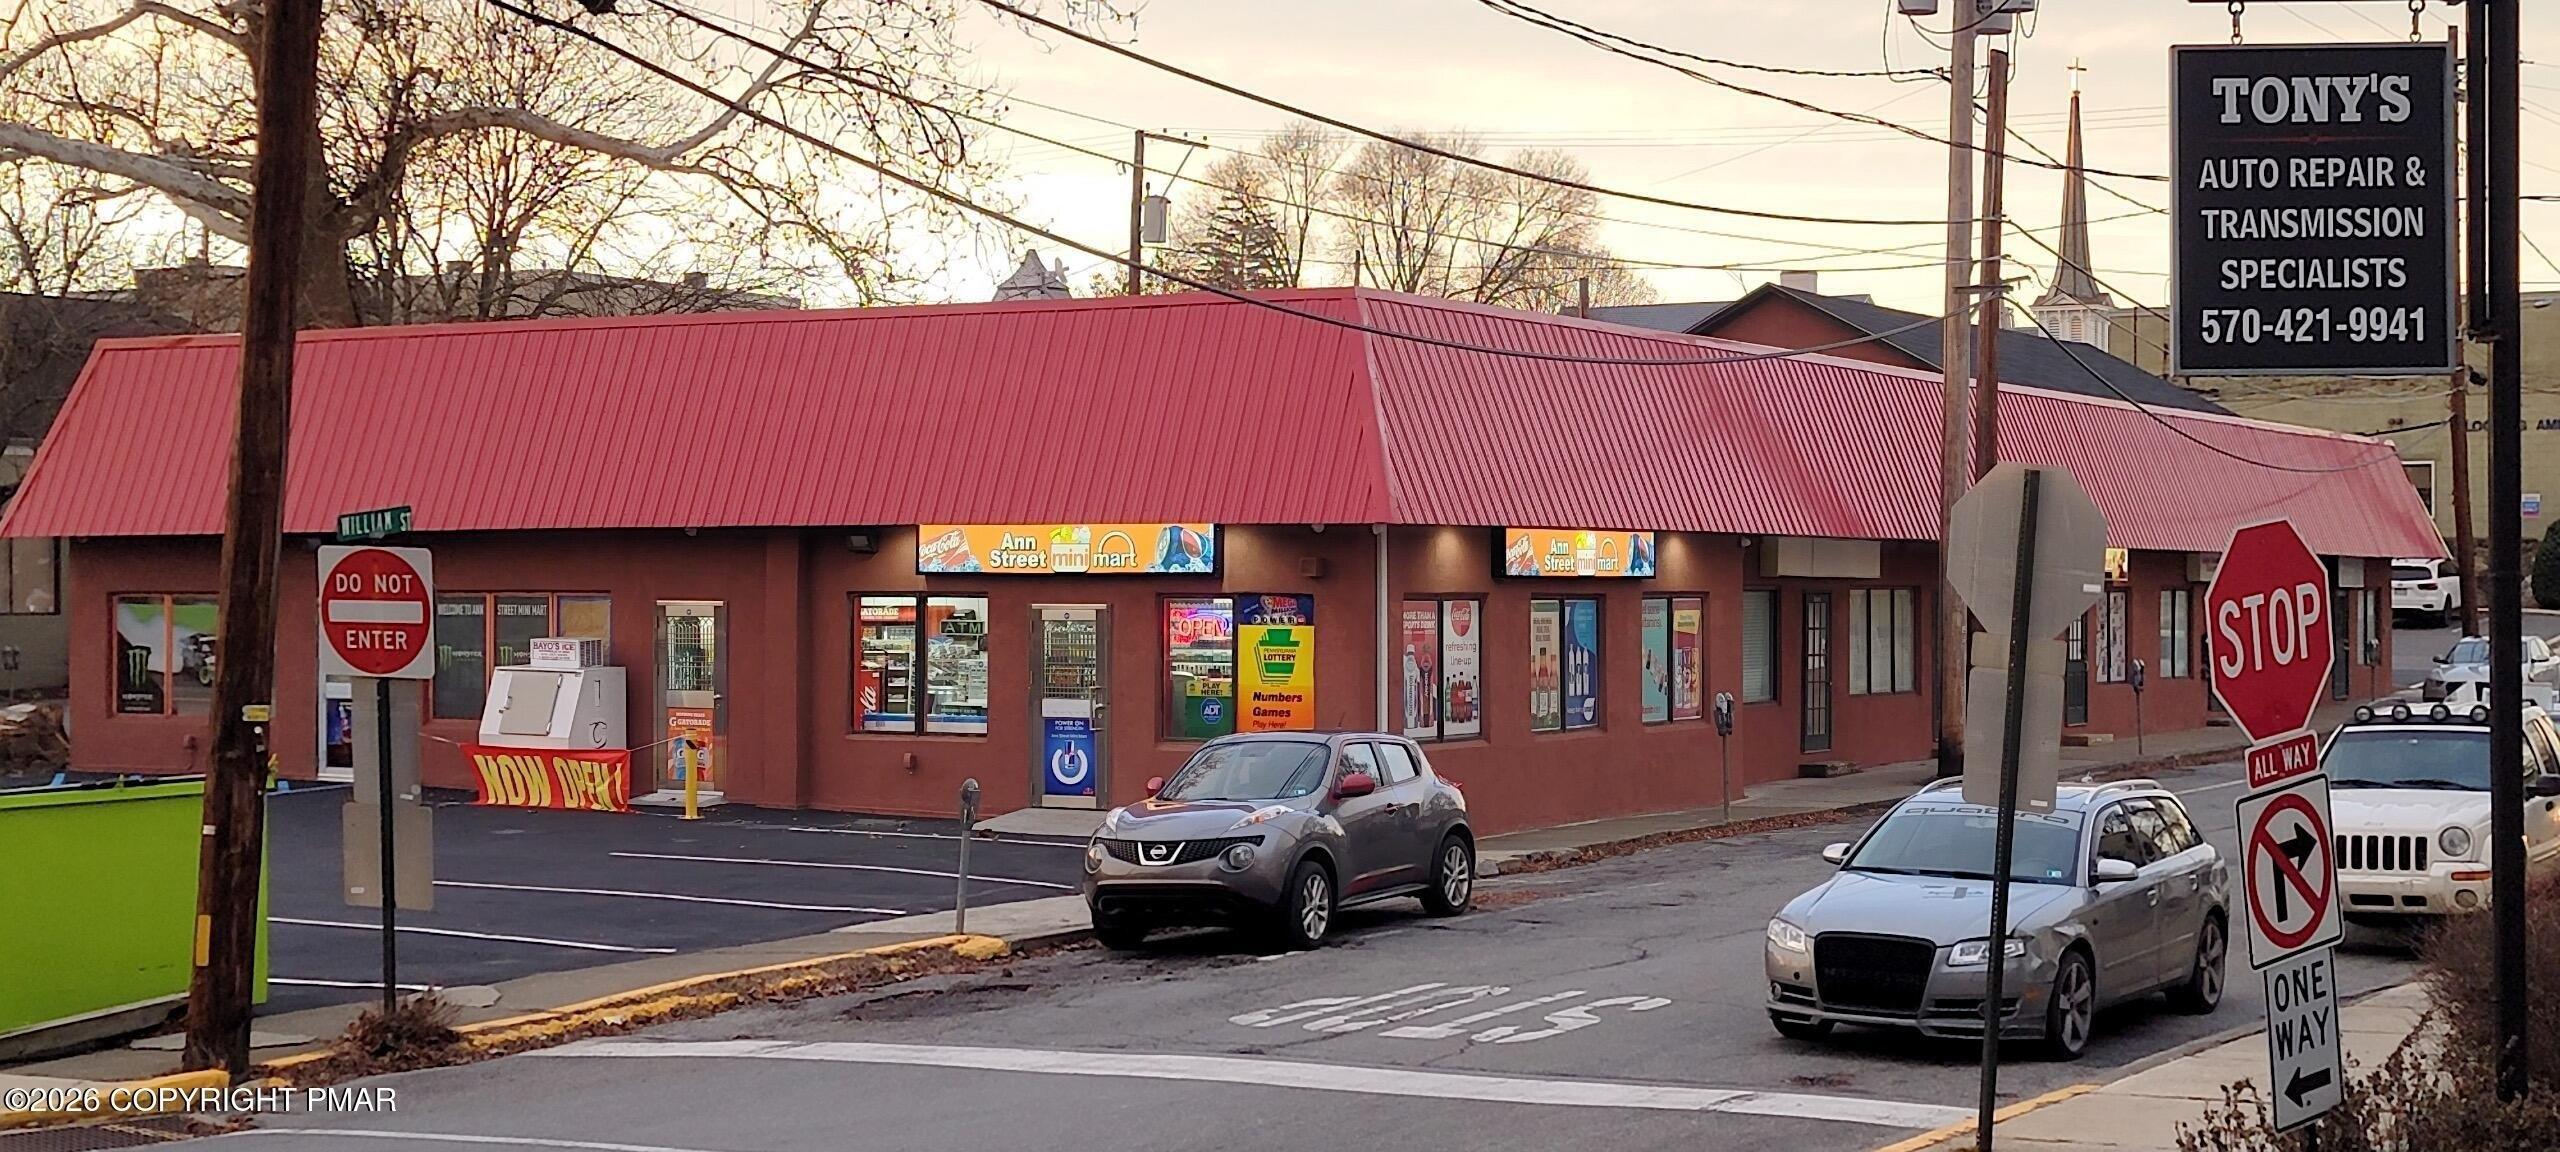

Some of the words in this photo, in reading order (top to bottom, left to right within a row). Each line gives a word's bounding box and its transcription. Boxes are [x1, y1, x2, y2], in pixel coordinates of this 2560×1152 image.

[2212, 73, 2411, 124] TONY'S
[2199, 158, 2280, 189] AUTO
[2289, 157, 2395, 188] REPAIR
[2405, 156, 2426, 187] &
[2201, 206, 2424, 239] TRANSMISSION
[2220, 258, 2407, 289] SPECIALISTS
[2201, 306, 2424, 343] 570-421-9941
[341, 511, 393, 536] WILLIAM
[1001, 532, 1037, 551] Ann
[1550, 538, 1569, 556] Ann
[989, 550, 1047, 568] Street
[1052, 548, 1088, 568] mini
[1093, 547, 1137, 568] mart
[1544, 554, 1575, 573] Street
[1598, 551, 1620, 571] mart
[335, 573, 361, 593] DO
[374, 574, 413, 594] NOT
[497, 604, 517, 616] STREET
[532, 604, 548, 616] MART
[945, 623, 981, 633] ATM
[1180, 618, 1226, 637] OPEN
[2218, 582, 2321, 679] STOP
[346, 630, 407, 650] ENTER
[533, 641, 560, 650] BAYO'S
[1253, 691, 1303, 703] Numbers
[1203, 704, 1221, 715] ADT
[1252, 706, 1291, 718] Games
[1252, 720, 1267, 728] Play
[1268, 720, 1287, 728] Here!
[2254, 756, 2278, 781] ALL
[2281, 742, 2311, 771] WAY
[473, 754, 551, 807] NOW
[2273, 960, 2327, 1012] ONE
[2275, 1006, 2329, 1061] WAY
